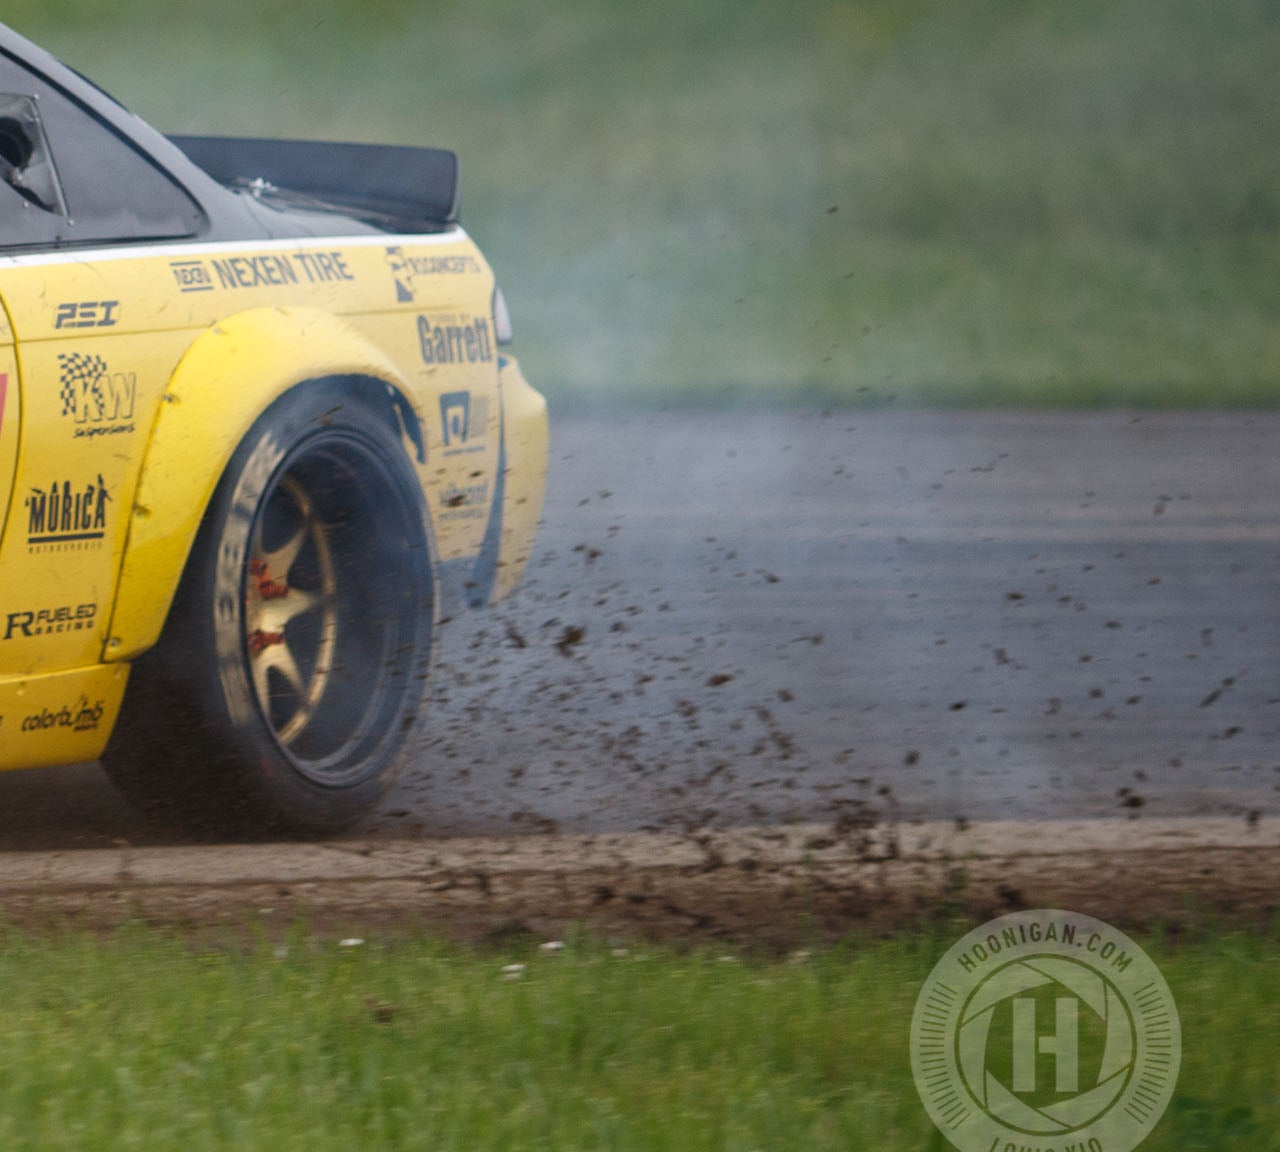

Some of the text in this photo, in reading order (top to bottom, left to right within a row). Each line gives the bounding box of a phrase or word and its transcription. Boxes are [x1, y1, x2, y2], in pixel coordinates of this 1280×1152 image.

[211, 252, 355, 289] NEXEN TIRE
[417, 314, 493, 365] Garrett
[74, 372, 136, 424] KW
[36, 603, 97, 624] FUELED
